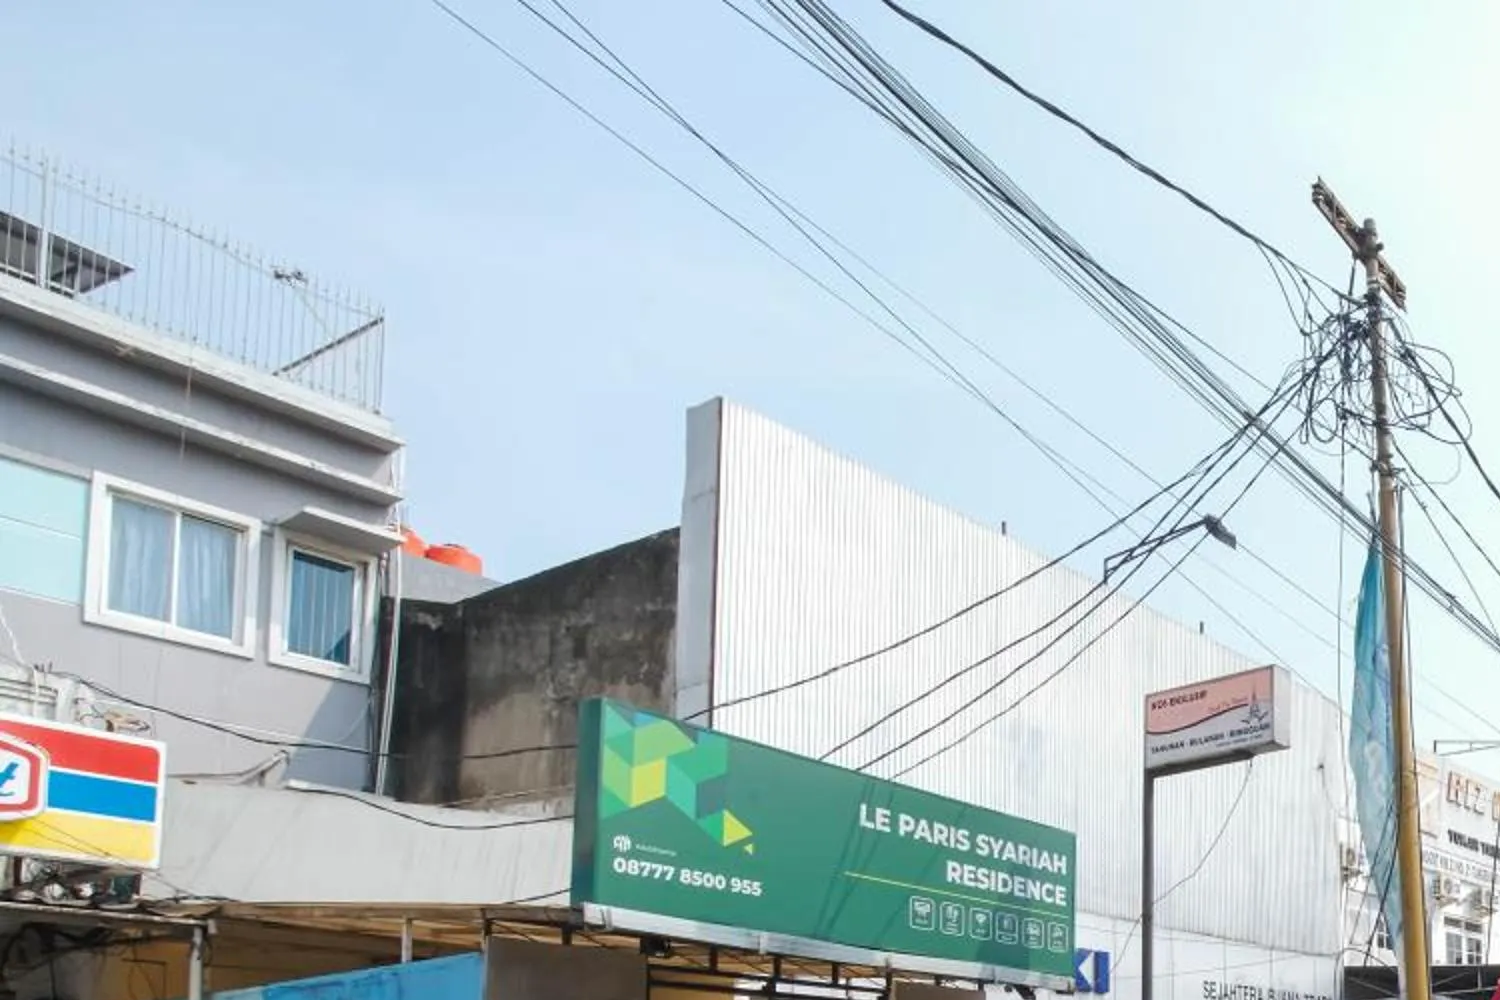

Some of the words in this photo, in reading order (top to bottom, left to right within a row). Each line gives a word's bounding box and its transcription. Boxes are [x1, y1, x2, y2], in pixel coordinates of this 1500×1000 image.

[859, 803, 892, 833] LE
[898, 813, 970, 851] PARIS
[975, 833, 1067, 875] SYARIAH
[613, 857, 675, 881] 08777
[679, 868, 726, 889] 8500
[730, 877, 763, 896] 955
[946, 860, 1067, 906] RESIDENCE
